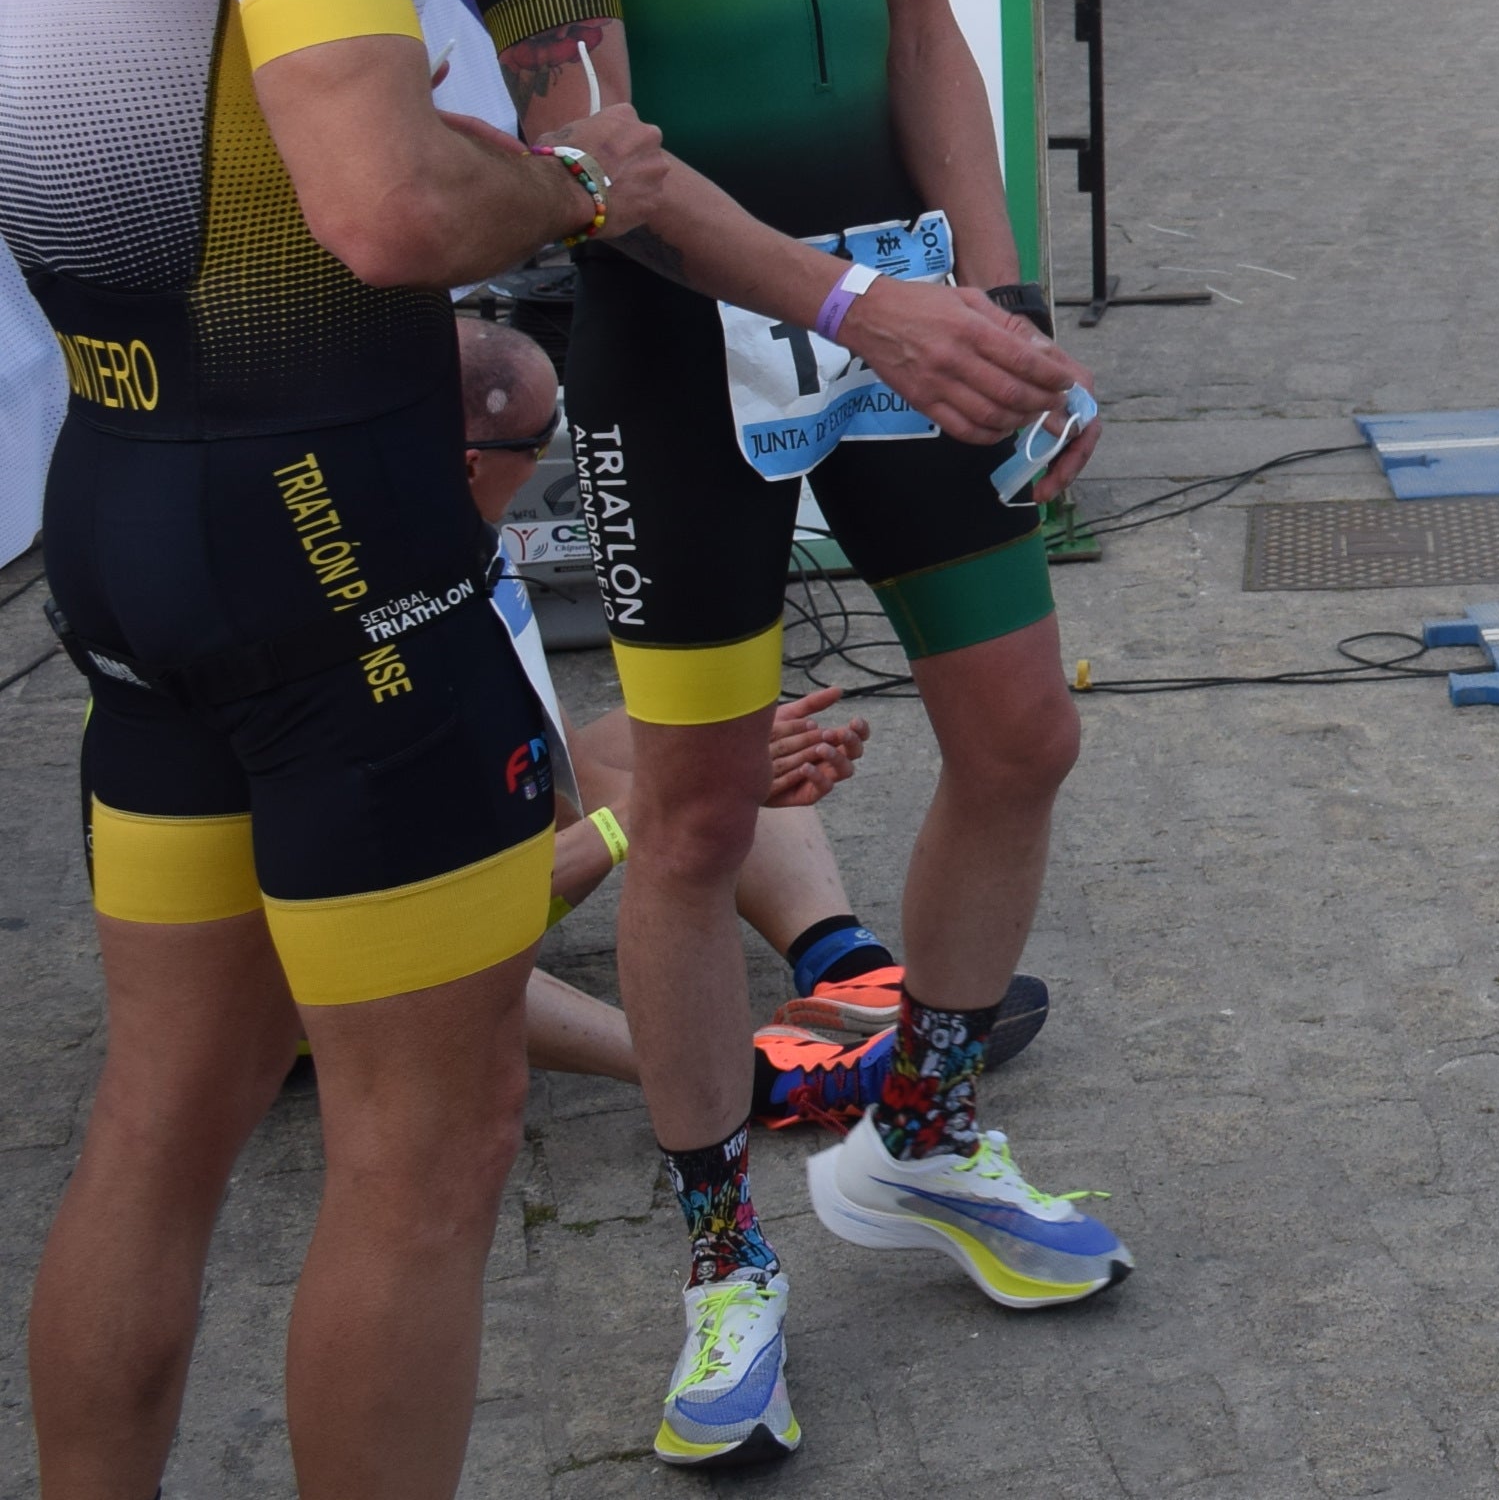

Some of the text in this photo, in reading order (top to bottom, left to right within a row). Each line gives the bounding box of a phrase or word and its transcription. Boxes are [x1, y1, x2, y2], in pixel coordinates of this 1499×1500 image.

[751, 427, 810, 459] JUNTA
[273, 453, 361, 585] TRIATLÓN
[573, 424, 616, 622] ALMENDRALEJO
[591, 424, 652, 627] TRIATLÓN
[359, 590, 430, 628] SETÚBAL
[365, 578, 475, 643] TRIATHLON
